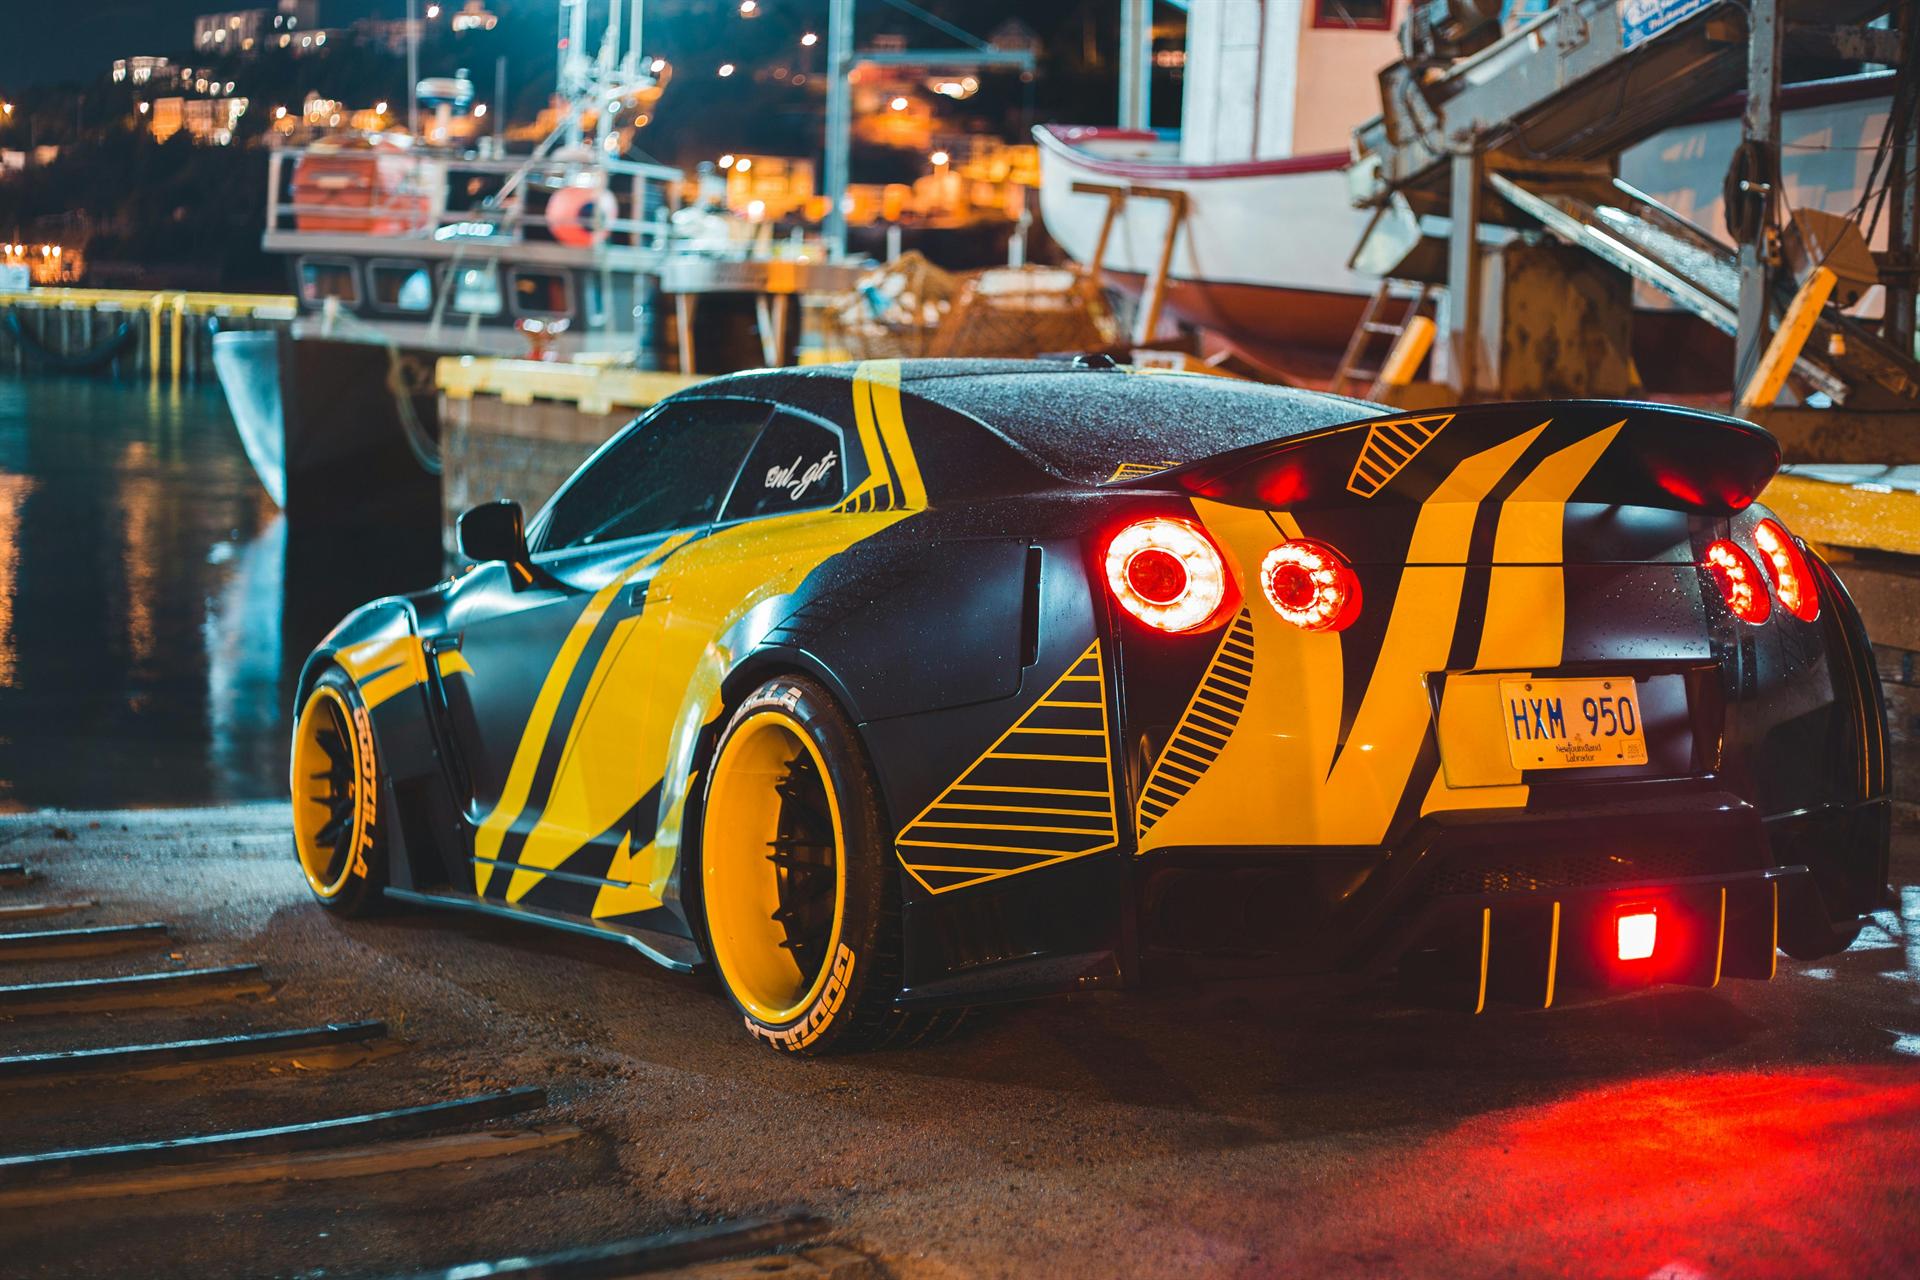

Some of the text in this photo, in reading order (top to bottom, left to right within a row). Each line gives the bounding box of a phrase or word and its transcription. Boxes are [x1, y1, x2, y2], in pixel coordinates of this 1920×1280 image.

[1511, 696, 1636, 740] HXM 950
[1556, 742, 1602, 755] Newfoundland
[1566, 753, 1595, 763] Labrador
[353, 705, 377, 879] GODZILLA
[744, 943, 855, 1052] GODZILLA
